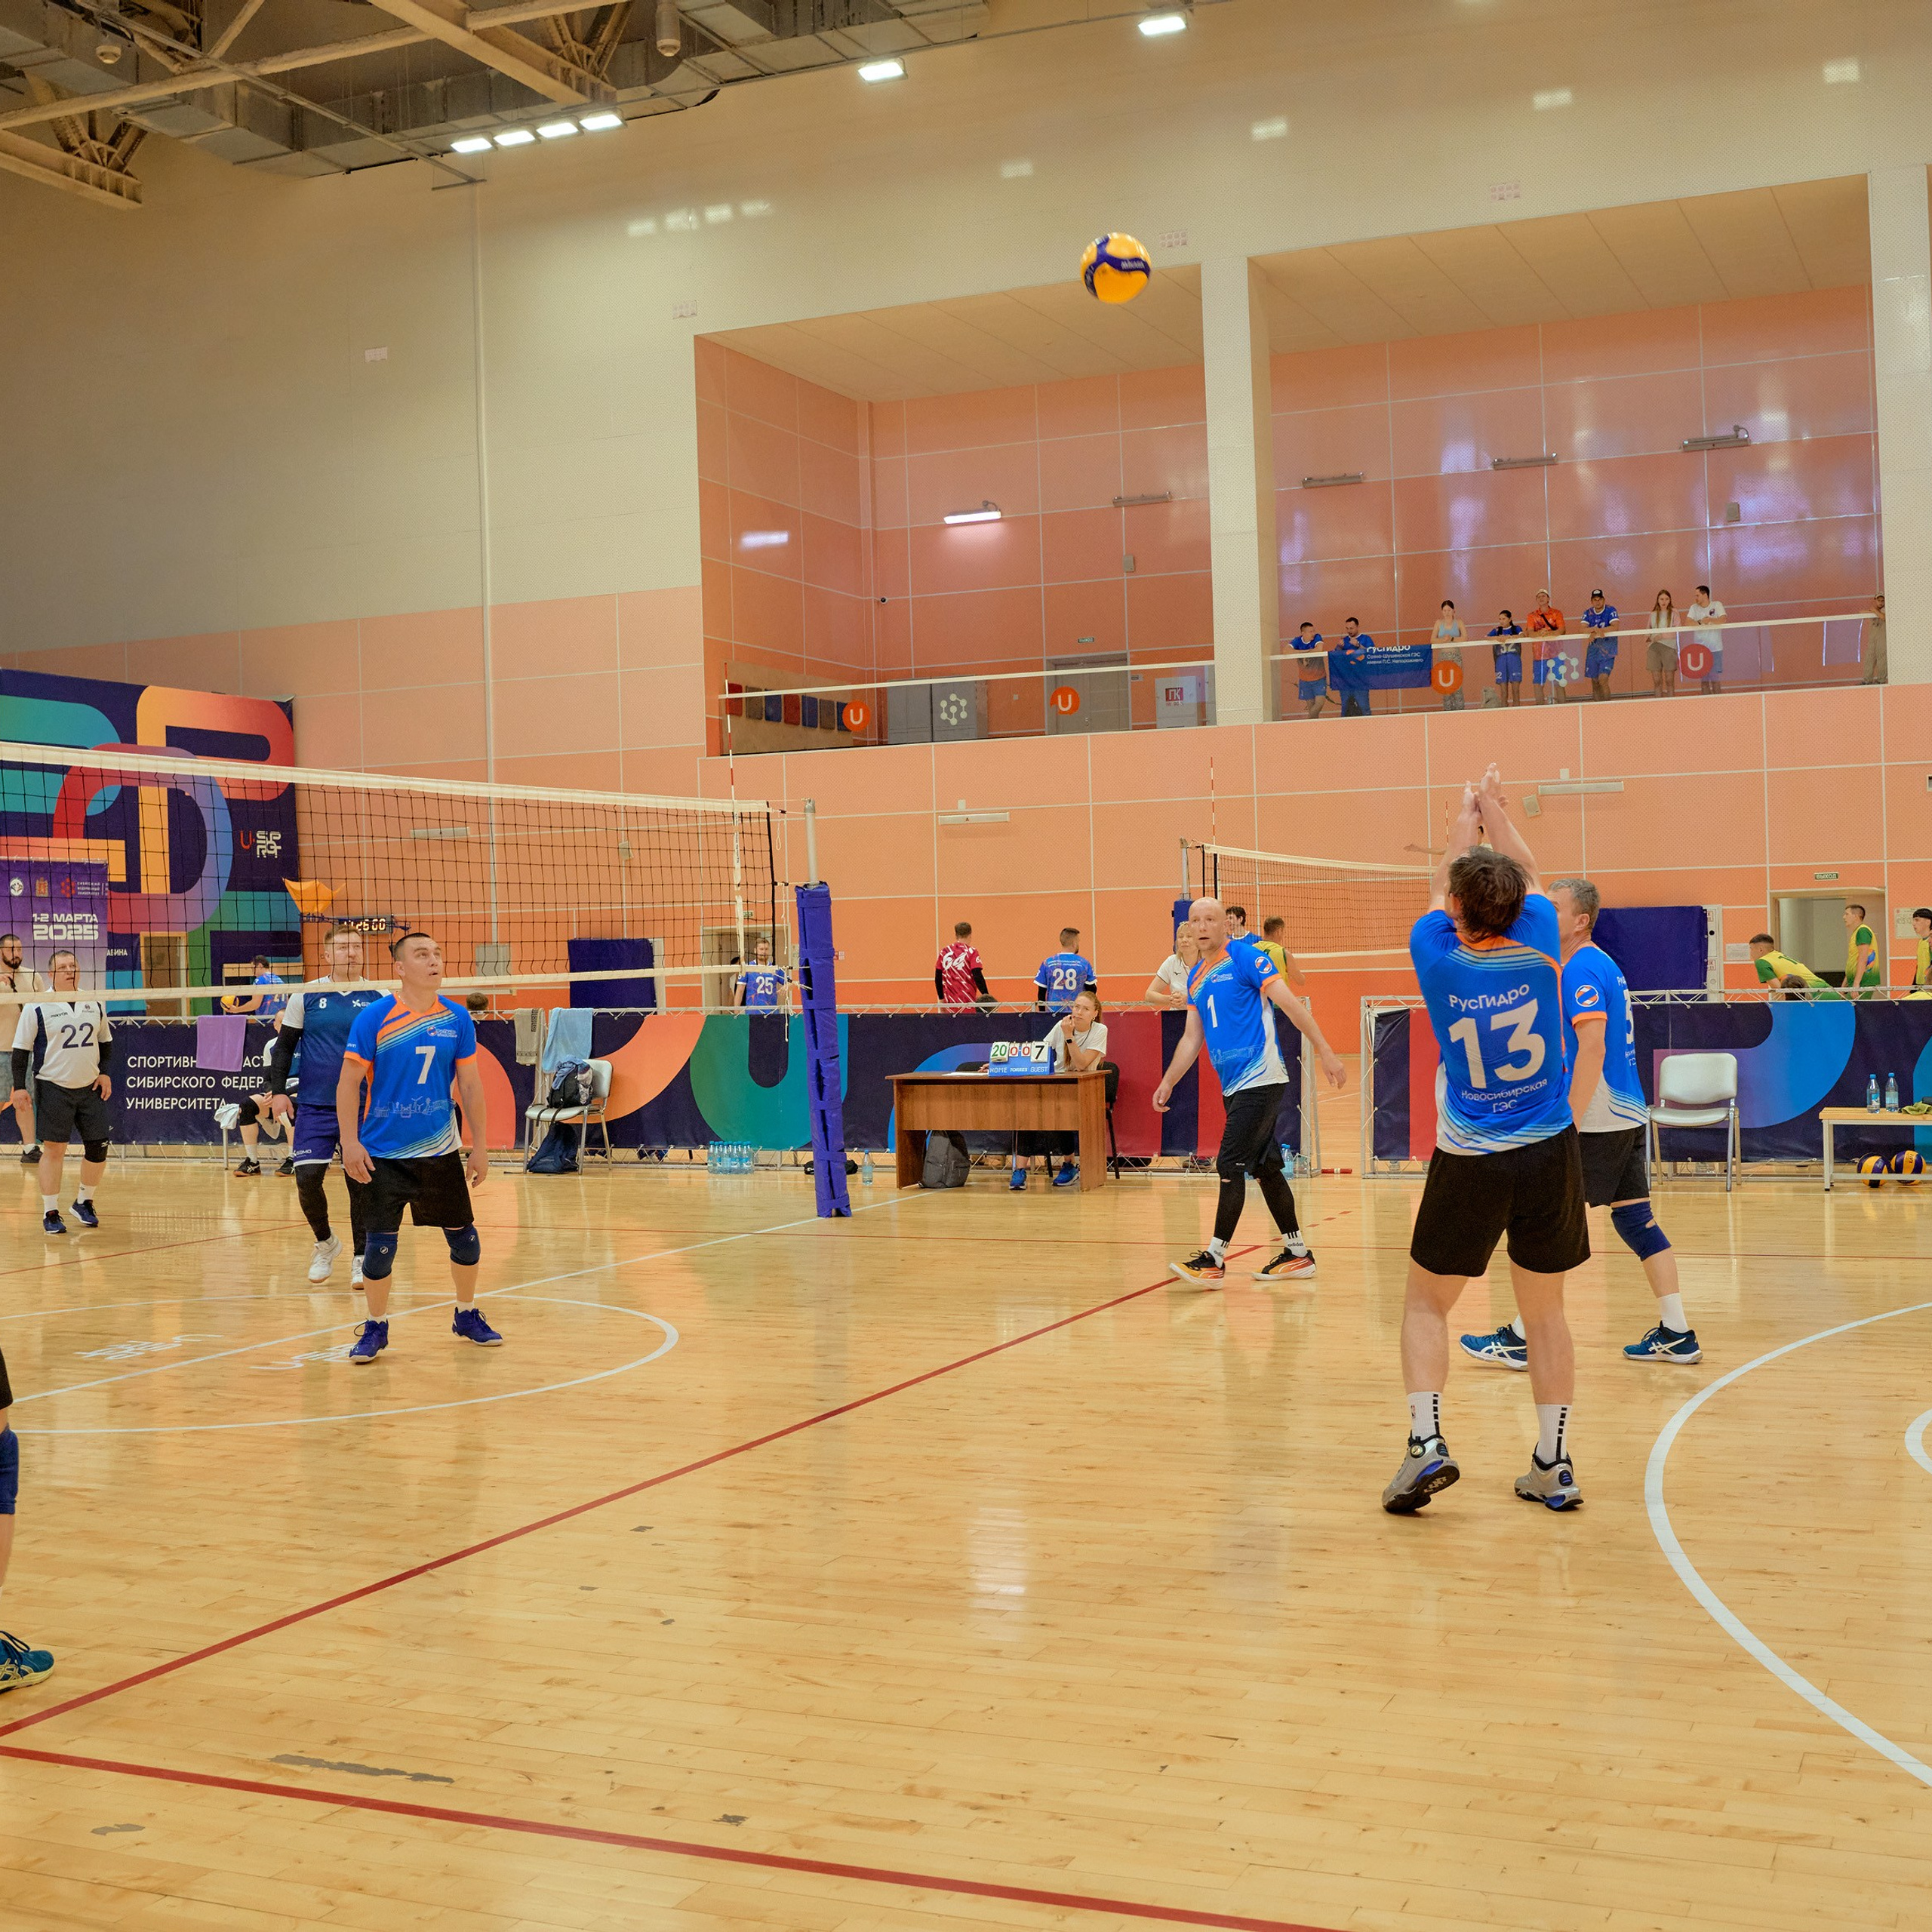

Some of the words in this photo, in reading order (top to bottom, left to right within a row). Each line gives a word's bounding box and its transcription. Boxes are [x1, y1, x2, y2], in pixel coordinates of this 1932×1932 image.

[1438, 669, 1454, 687] U
[1058, 694, 1072, 711] U
[850, 709, 863, 724] U
[32, 913, 49, 922] 1-2
[53, 913, 98, 923] МАРТА
[33, 924, 99, 940] 2025
[943, 952, 966, 971] 64
[755, 976, 774, 995] 25
[1053, 968, 1077, 990] 28
[319, 998, 328, 1009] 8
[1448, 984, 1530, 1012] РусГидро
[1208, 994, 1218, 1028] 1
[61, 1023, 94, 1049] 22
[1448, 998, 1546, 1088] 13
[992, 1044, 1007, 1057] 20
[1035, 1045, 1044, 1060] 7
[127, 1057, 197, 1068] СПОРТИВН
[415, 1046, 436, 1084] 7
[126, 1076, 215, 1088] СИБИРСКОГО
[221, 1075, 264, 1090] ФЕДЕР
[1462, 1079, 1547, 1101] Новосибирская
[126, 1097, 226, 1110] УНИВЕРСИТЕТА
[1493, 1099, 1518, 1113] ГЭС
